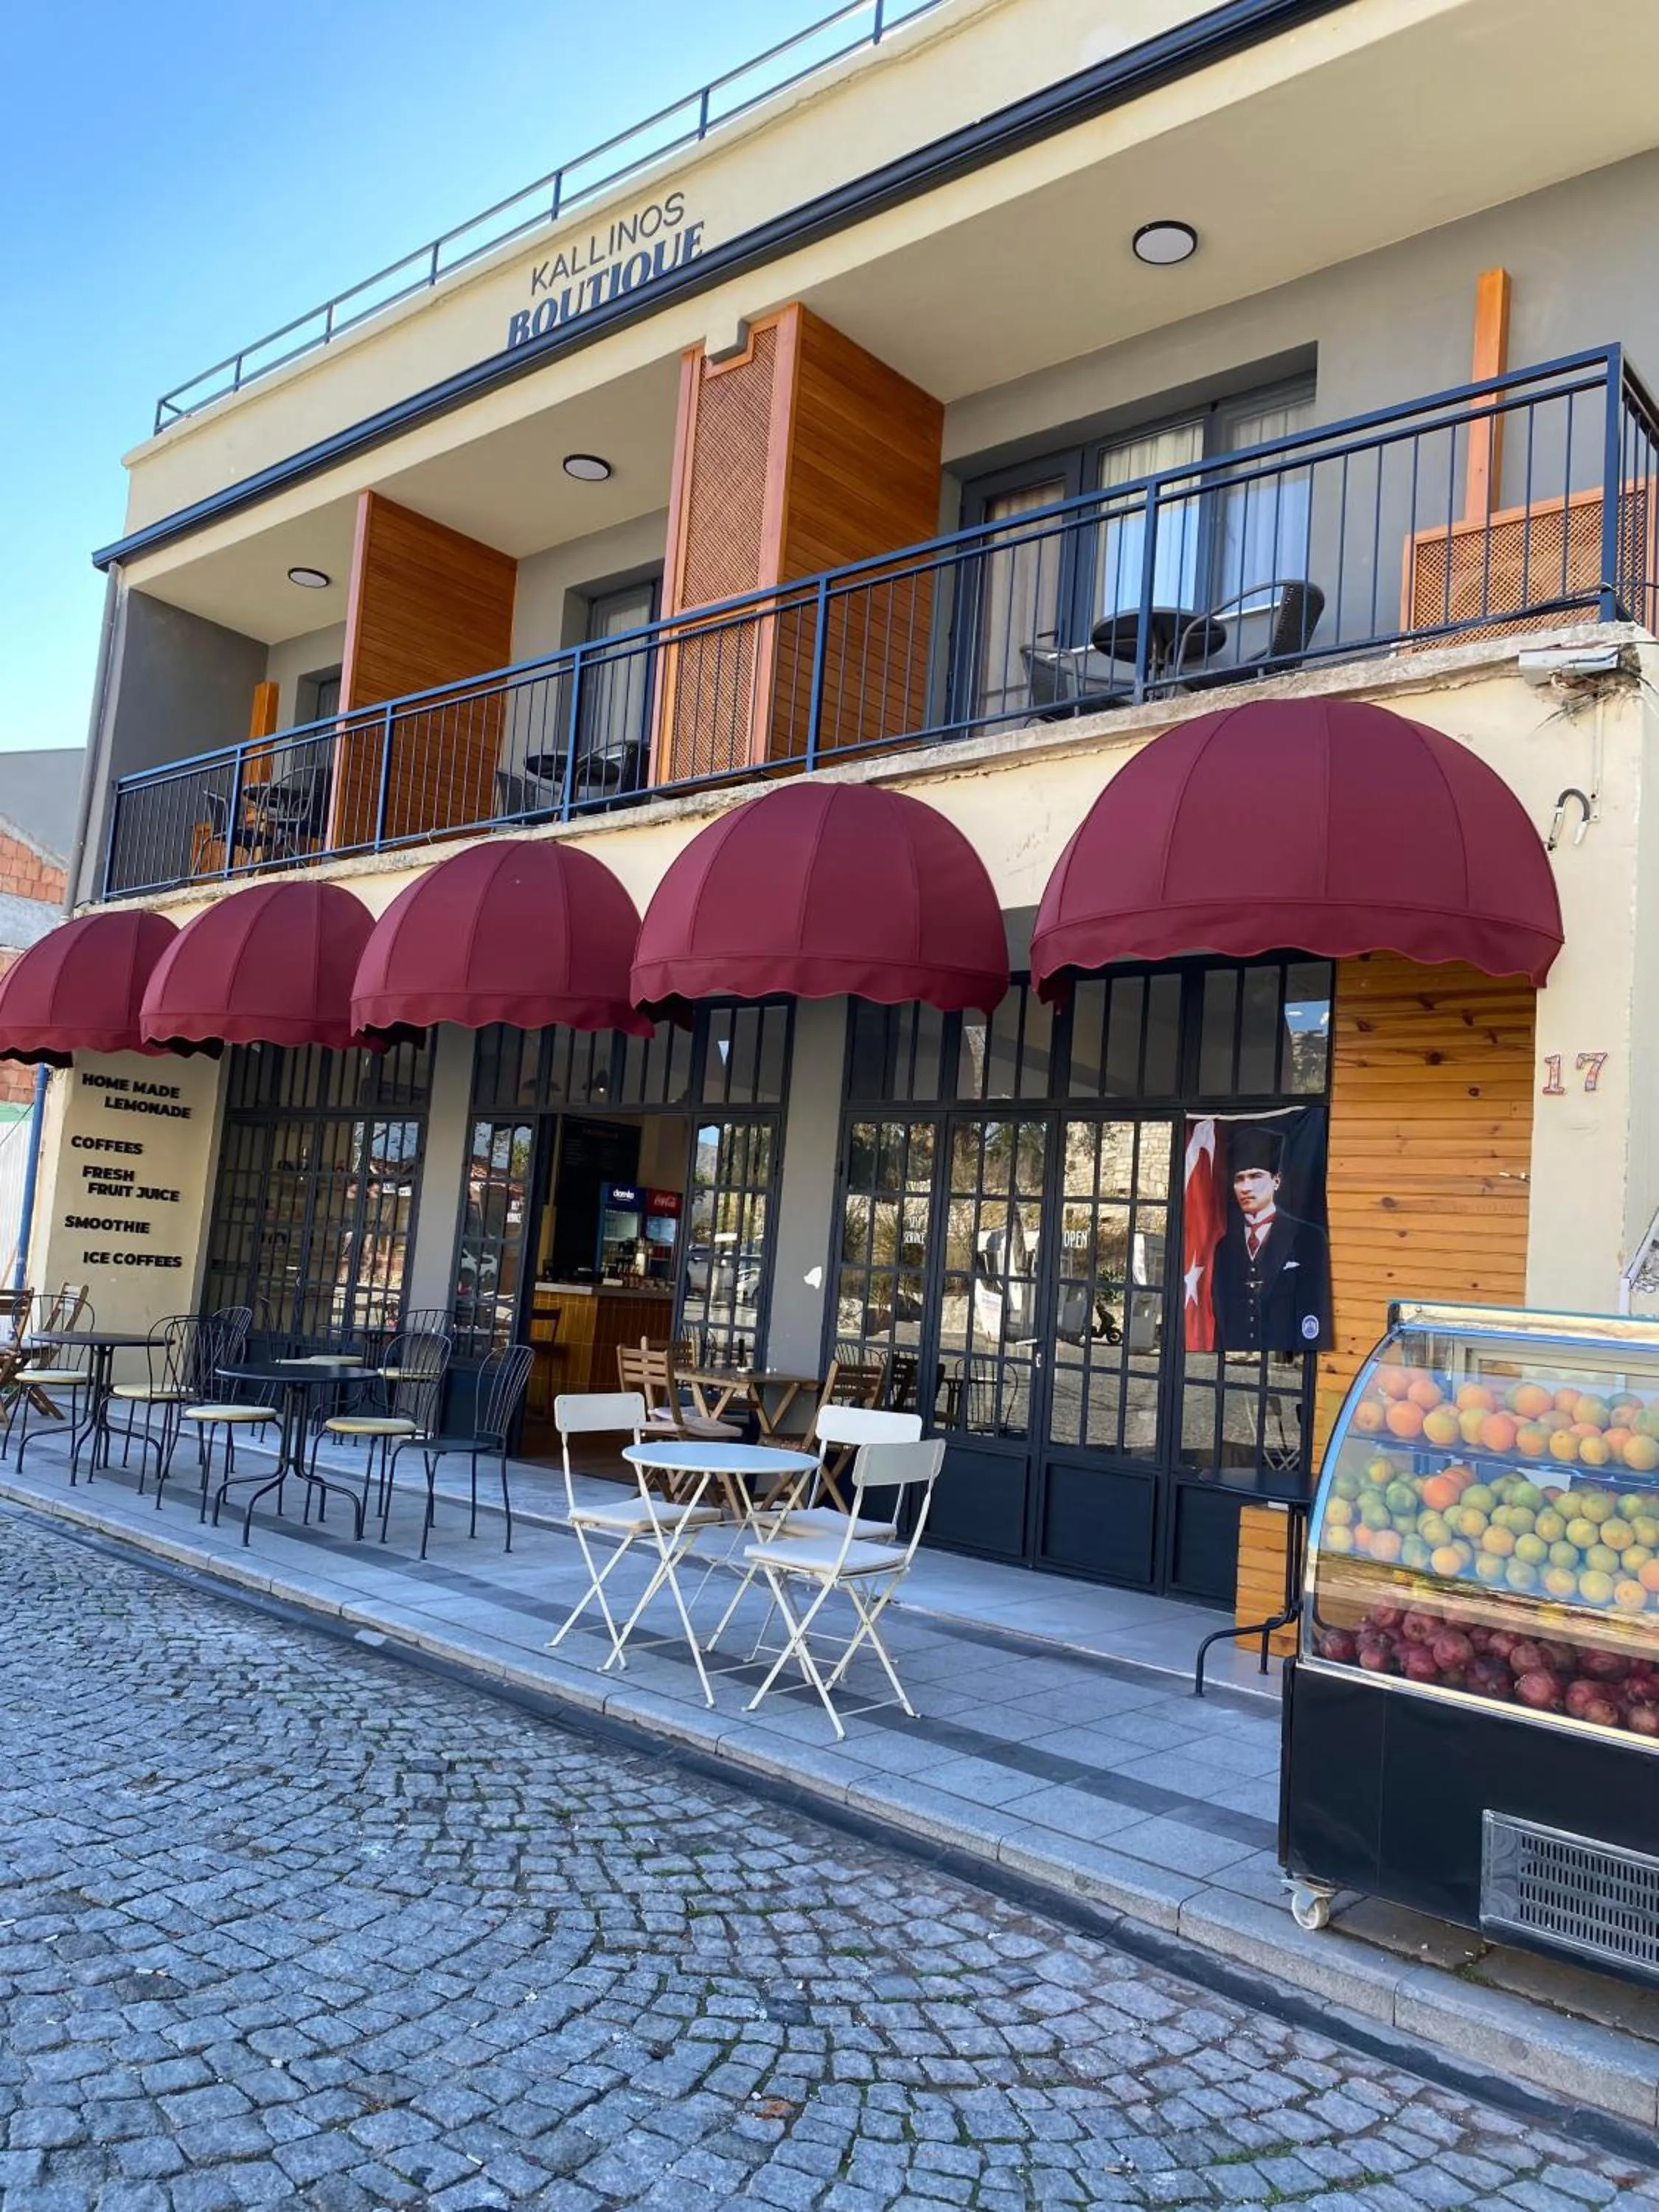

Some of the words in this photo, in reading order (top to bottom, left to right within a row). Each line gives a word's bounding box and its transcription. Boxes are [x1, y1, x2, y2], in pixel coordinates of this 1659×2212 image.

[531, 191, 686, 296] KALLINOS
[507, 220, 705, 350] BOUTIQUE
[1542, 1052, 1608, 1095] 17
[82, 1073, 129, 1091] HOME
[133, 1080, 181, 1099] MADE
[105, 1096, 192, 1119] LEMONADE
[71, 1135, 143, 1155] COFFEES
[82, 1165, 135, 1182] FRESH
[88, 1182, 133, 1198] FRUIT
[136, 1186, 181, 1203] JUICE
[64, 1215, 150, 1234] SMOOTHIE
[1064, 1230, 1088, 1249] OPEN
[83, 1251, 110, 1265] ICE
[113, 1253, 183, 1268] COFFEES
